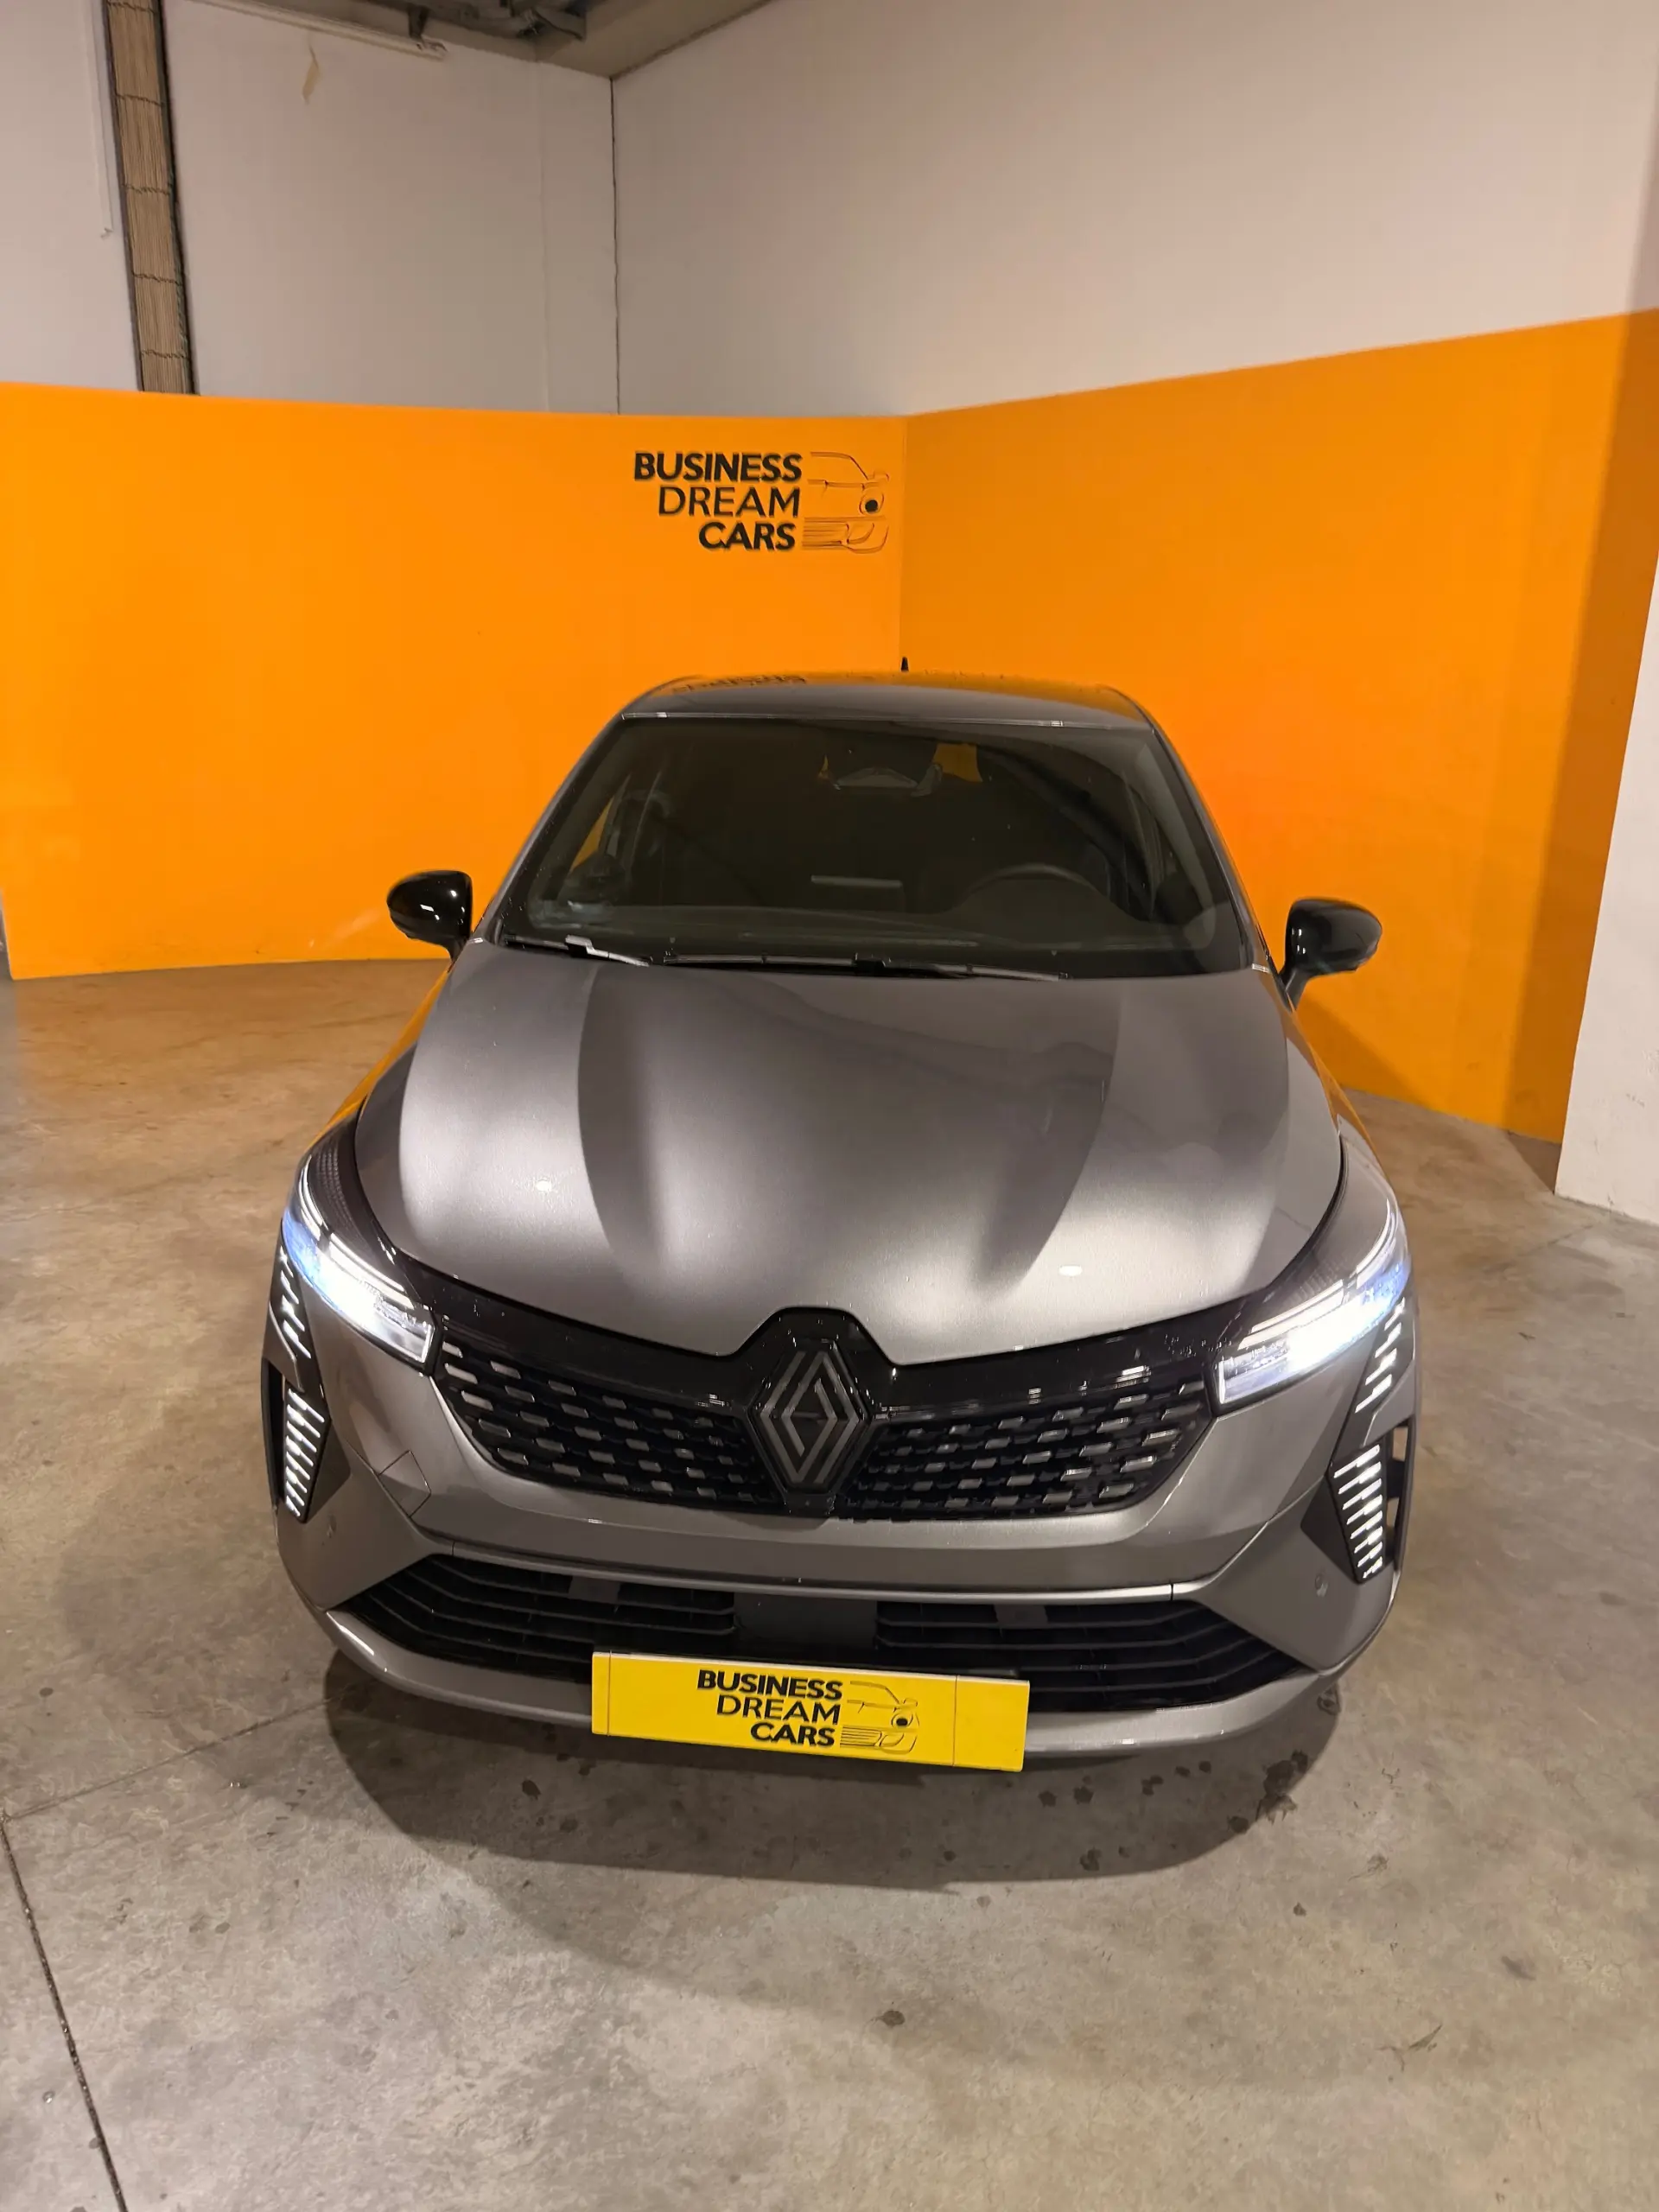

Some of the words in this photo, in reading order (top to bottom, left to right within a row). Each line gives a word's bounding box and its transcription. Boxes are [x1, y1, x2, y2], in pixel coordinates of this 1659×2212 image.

[633, 452, 802, 482] BUSINESS
[658, 486, 800, 518] DREAM
[698, 522, 796, 550] CARS
[696, 1669, 843, 1701] BUSINESS
[716, 1694, 841, 1726] DREAM
[750, 1723, 836, 1747] CARS
